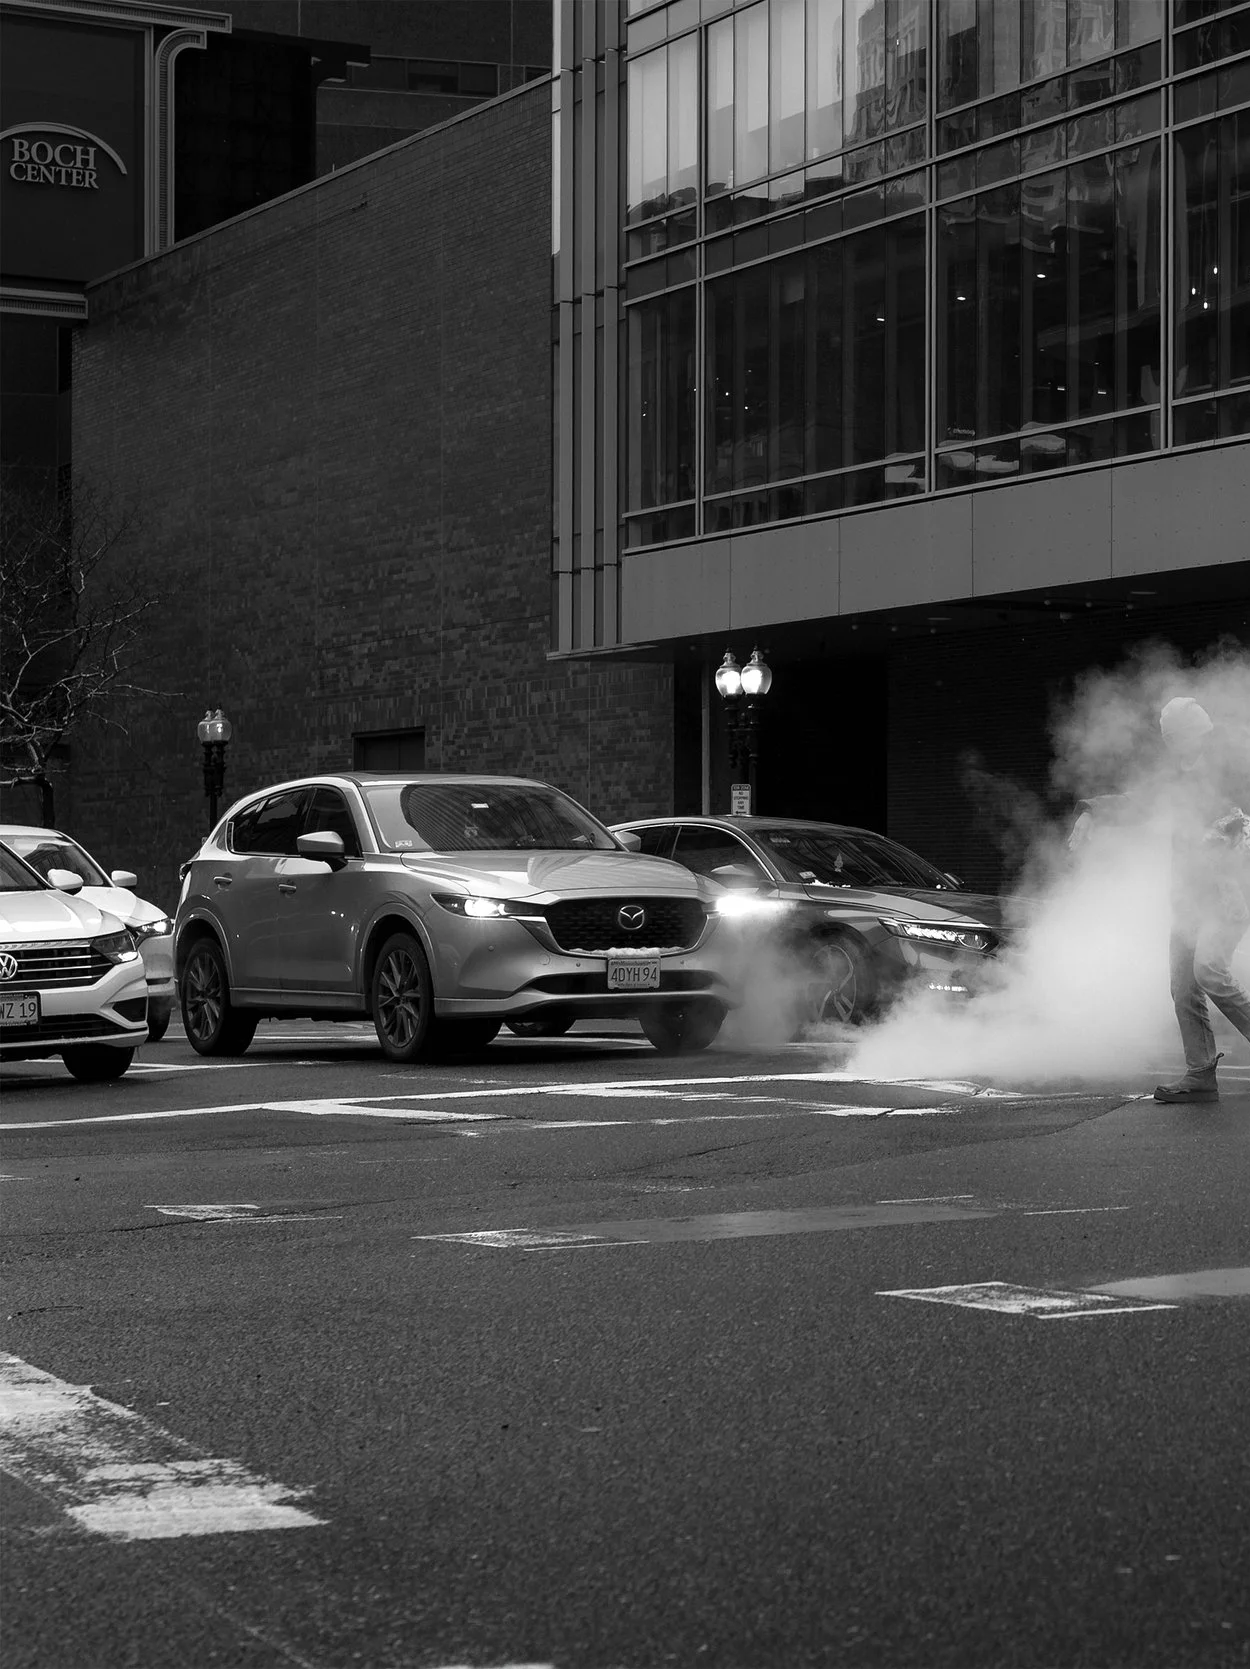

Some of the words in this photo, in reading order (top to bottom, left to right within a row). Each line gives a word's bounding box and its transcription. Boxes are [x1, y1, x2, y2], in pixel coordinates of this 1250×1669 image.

[11, 138, 97, 170] BOCH
[9, 162, 100, 190] CENTER
[611, 967, 640, 982] 4DYH
[642, 967, 657, 982] 94
[19, 1002, 36, 1018] 19
